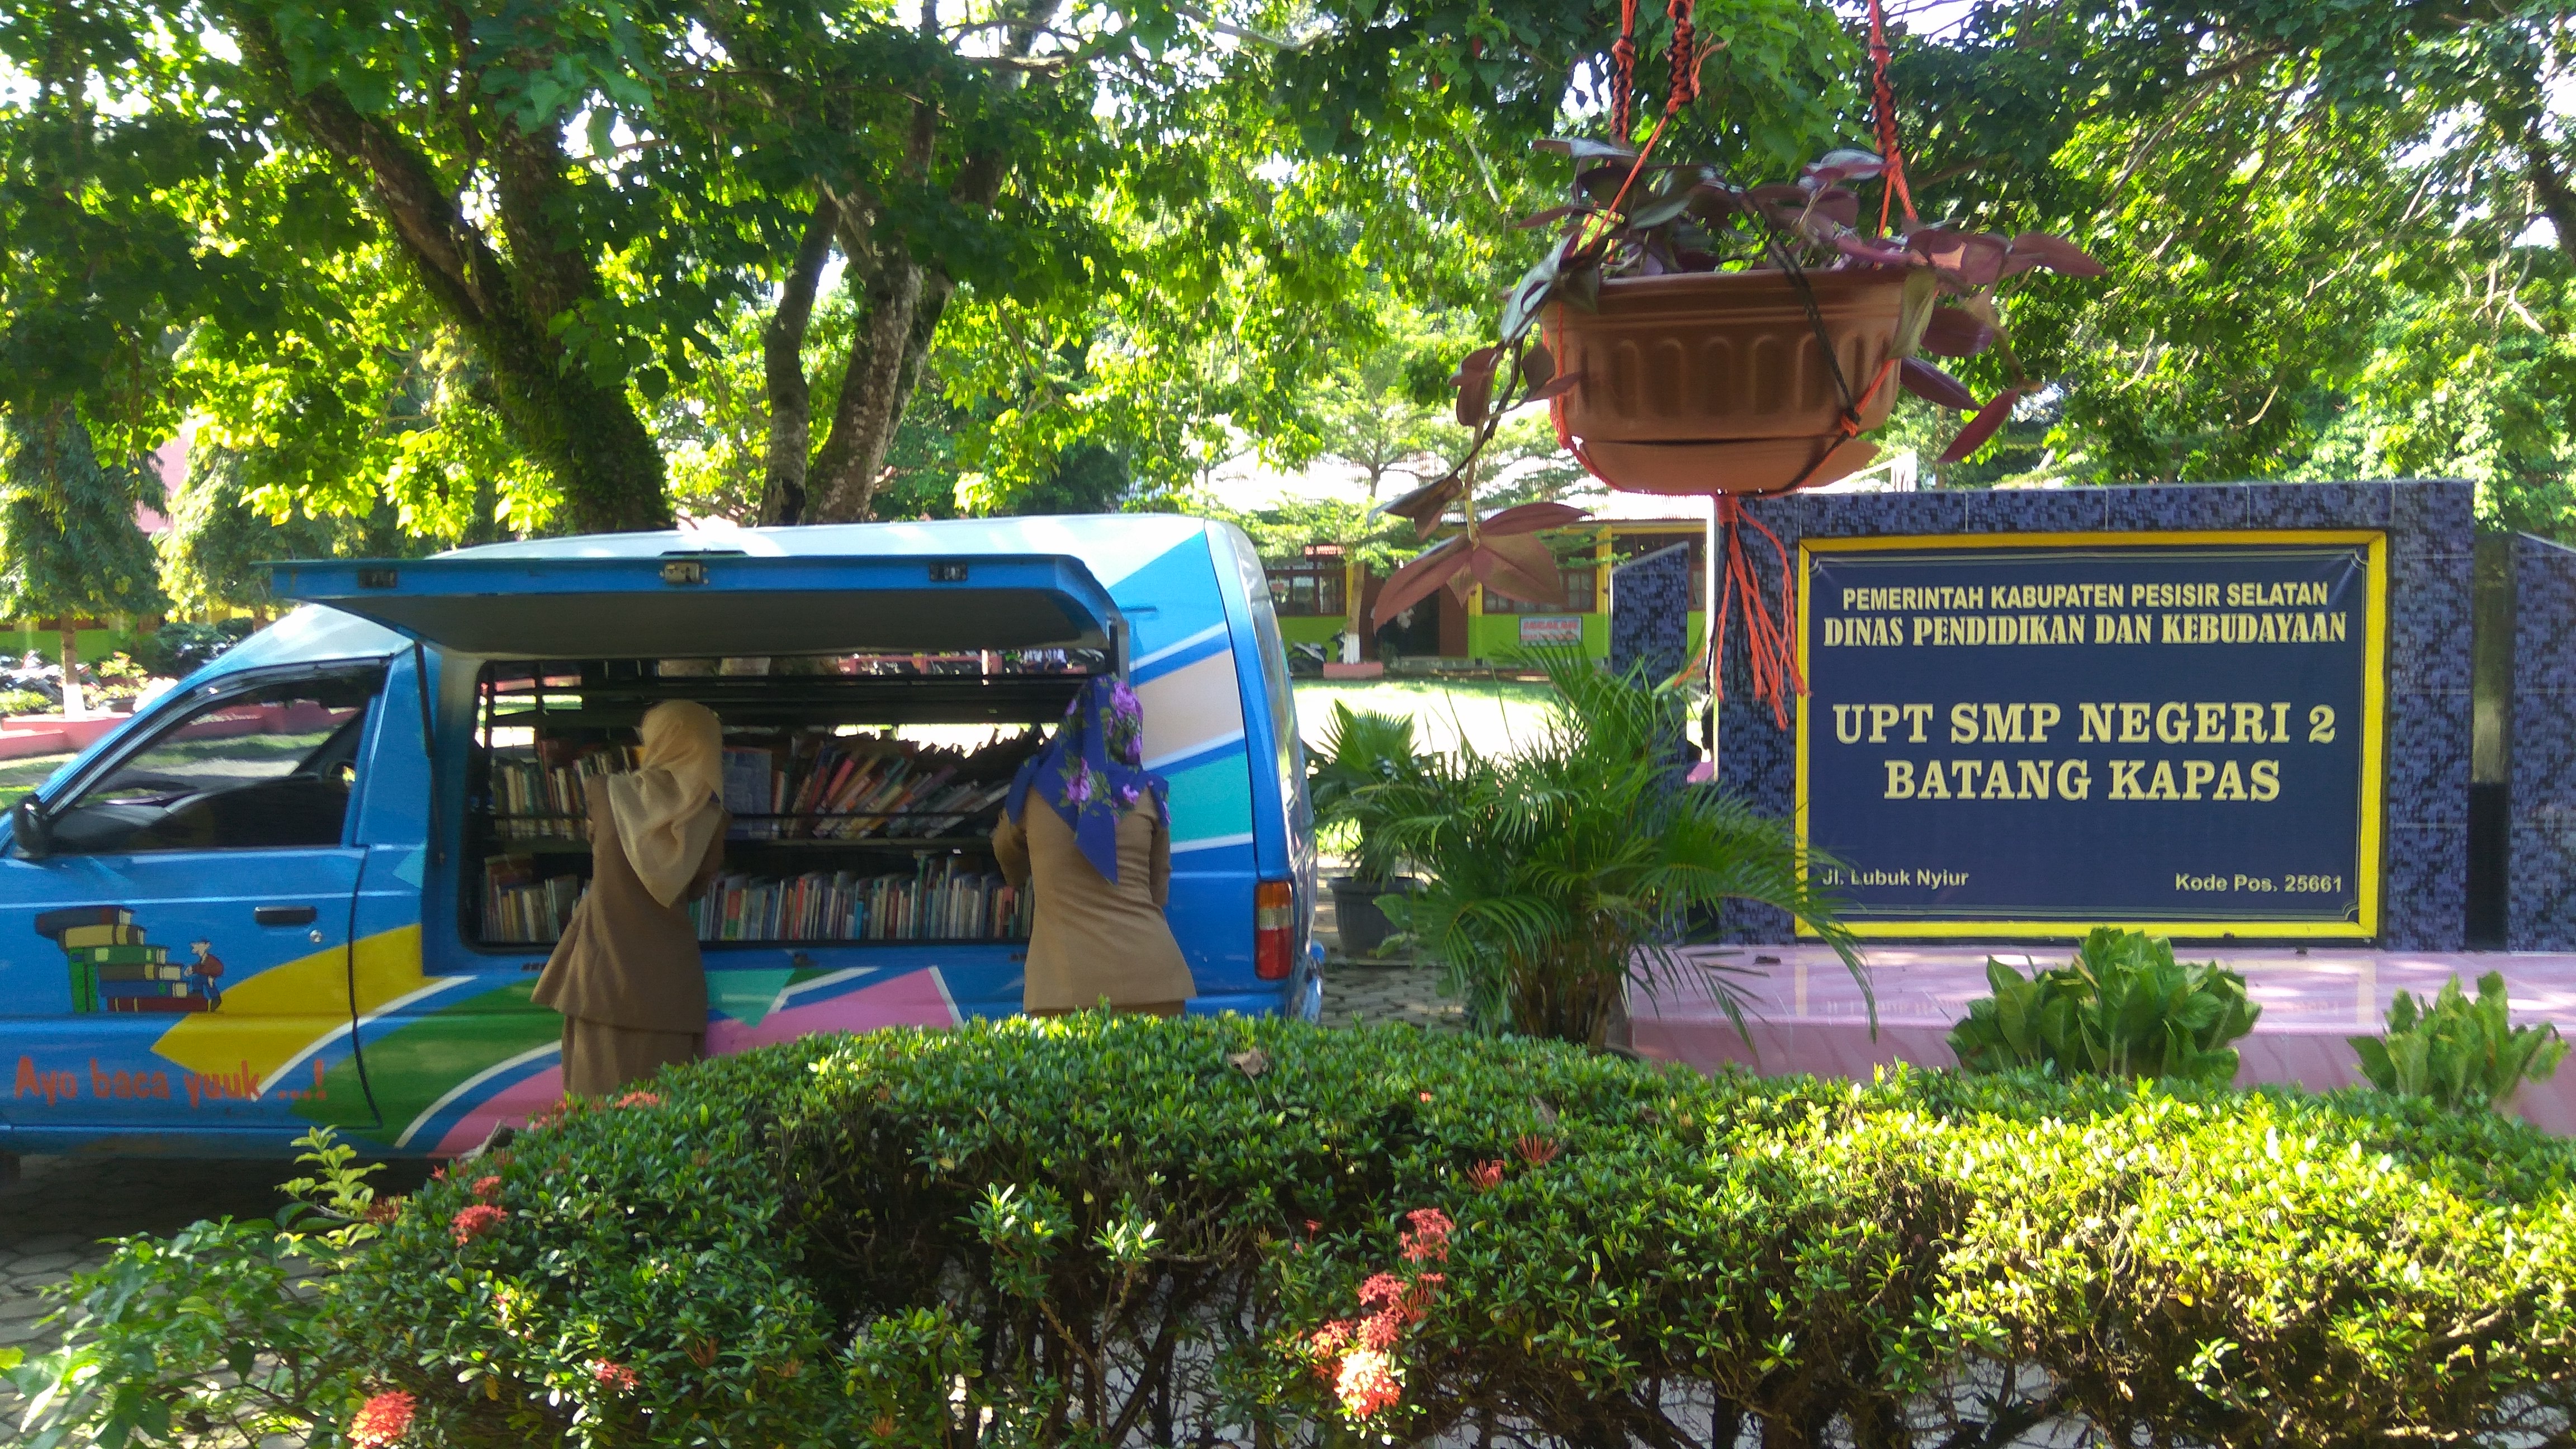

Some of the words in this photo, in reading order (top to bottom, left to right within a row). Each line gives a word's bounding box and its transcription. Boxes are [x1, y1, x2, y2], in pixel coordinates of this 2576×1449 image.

[1843, 586, 1984, 611] PEMERINTAH
[1991, 584, 2124, 609] KABUPATEN
[2131, 583, 2220, 608] PESISIR
[2227, 581, 2329, 607] SELATAN
[1824, 617, 1904, 647] DINAS
[1913, 614, 2085, 646] PENDIDIKAN
[2094, 613, 2152, 645] DAN
[2161, 610, 2347, 645] KEBUDAYAAN
[1832, 703, 1934, 744] UPT
[1950, 703, 2061, 744] SMP
[2078, 702, 2291, 744] NEGERI
[2308, 704, 2336, 744] 2
[1884, 759, 2092, 801] BATANG
[2108, 759, 2281, 802] KAPAS
[1822, 868, 1844, 886] Jl.
[1850, 868, 1911, 886] Lubuk
[1917, 869, 1969, 890] Nyiur
[2175, 873, 2228, 891] Kode
[2234, 874, 2278, 892] Pos.
[2285, 874, 2342, 893] 25661
[15, 1055, 78, 1106] Ayo
[89, 1058, 170, 1099] baca
[183, 1060, 260, 1107] yuuk
